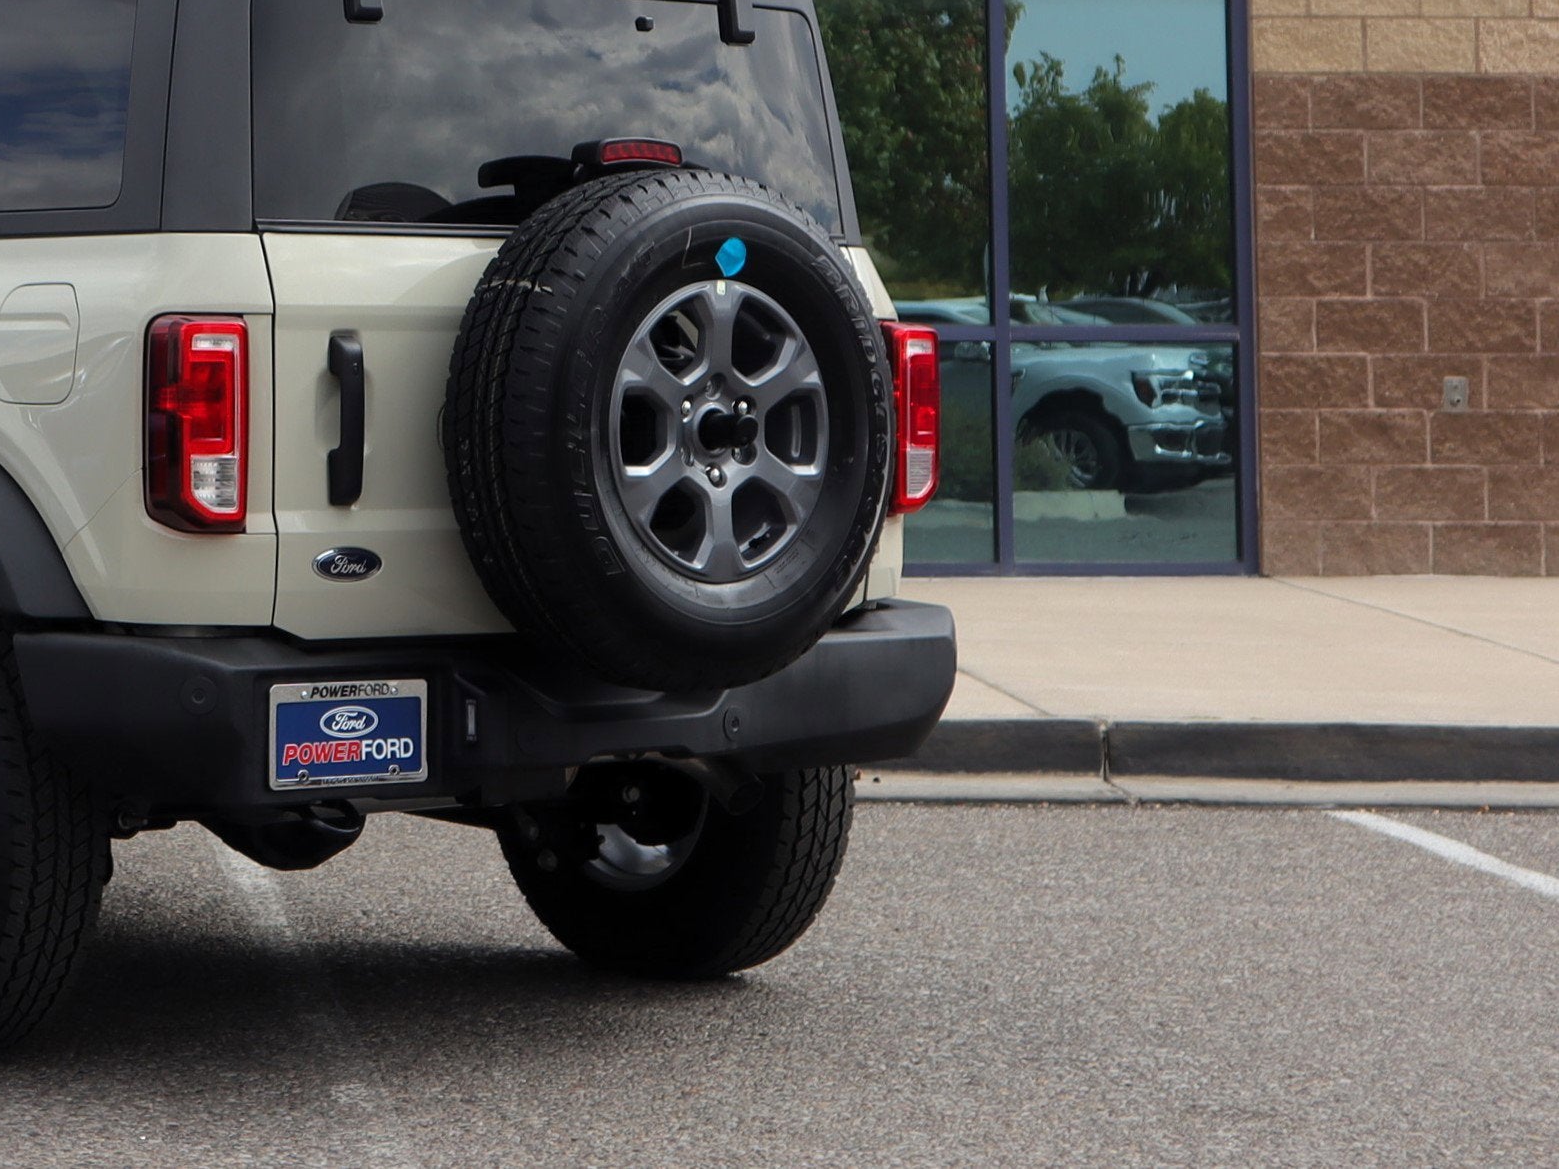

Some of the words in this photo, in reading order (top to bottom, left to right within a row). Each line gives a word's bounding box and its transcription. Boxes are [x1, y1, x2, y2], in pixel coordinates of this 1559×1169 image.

[330, 554, 367, 574] Ford
[309, 682, 391, 700] POWERFORD
[331, 710, 366, 731] Ford
[281, 737, 415, 766] POWERFORD
